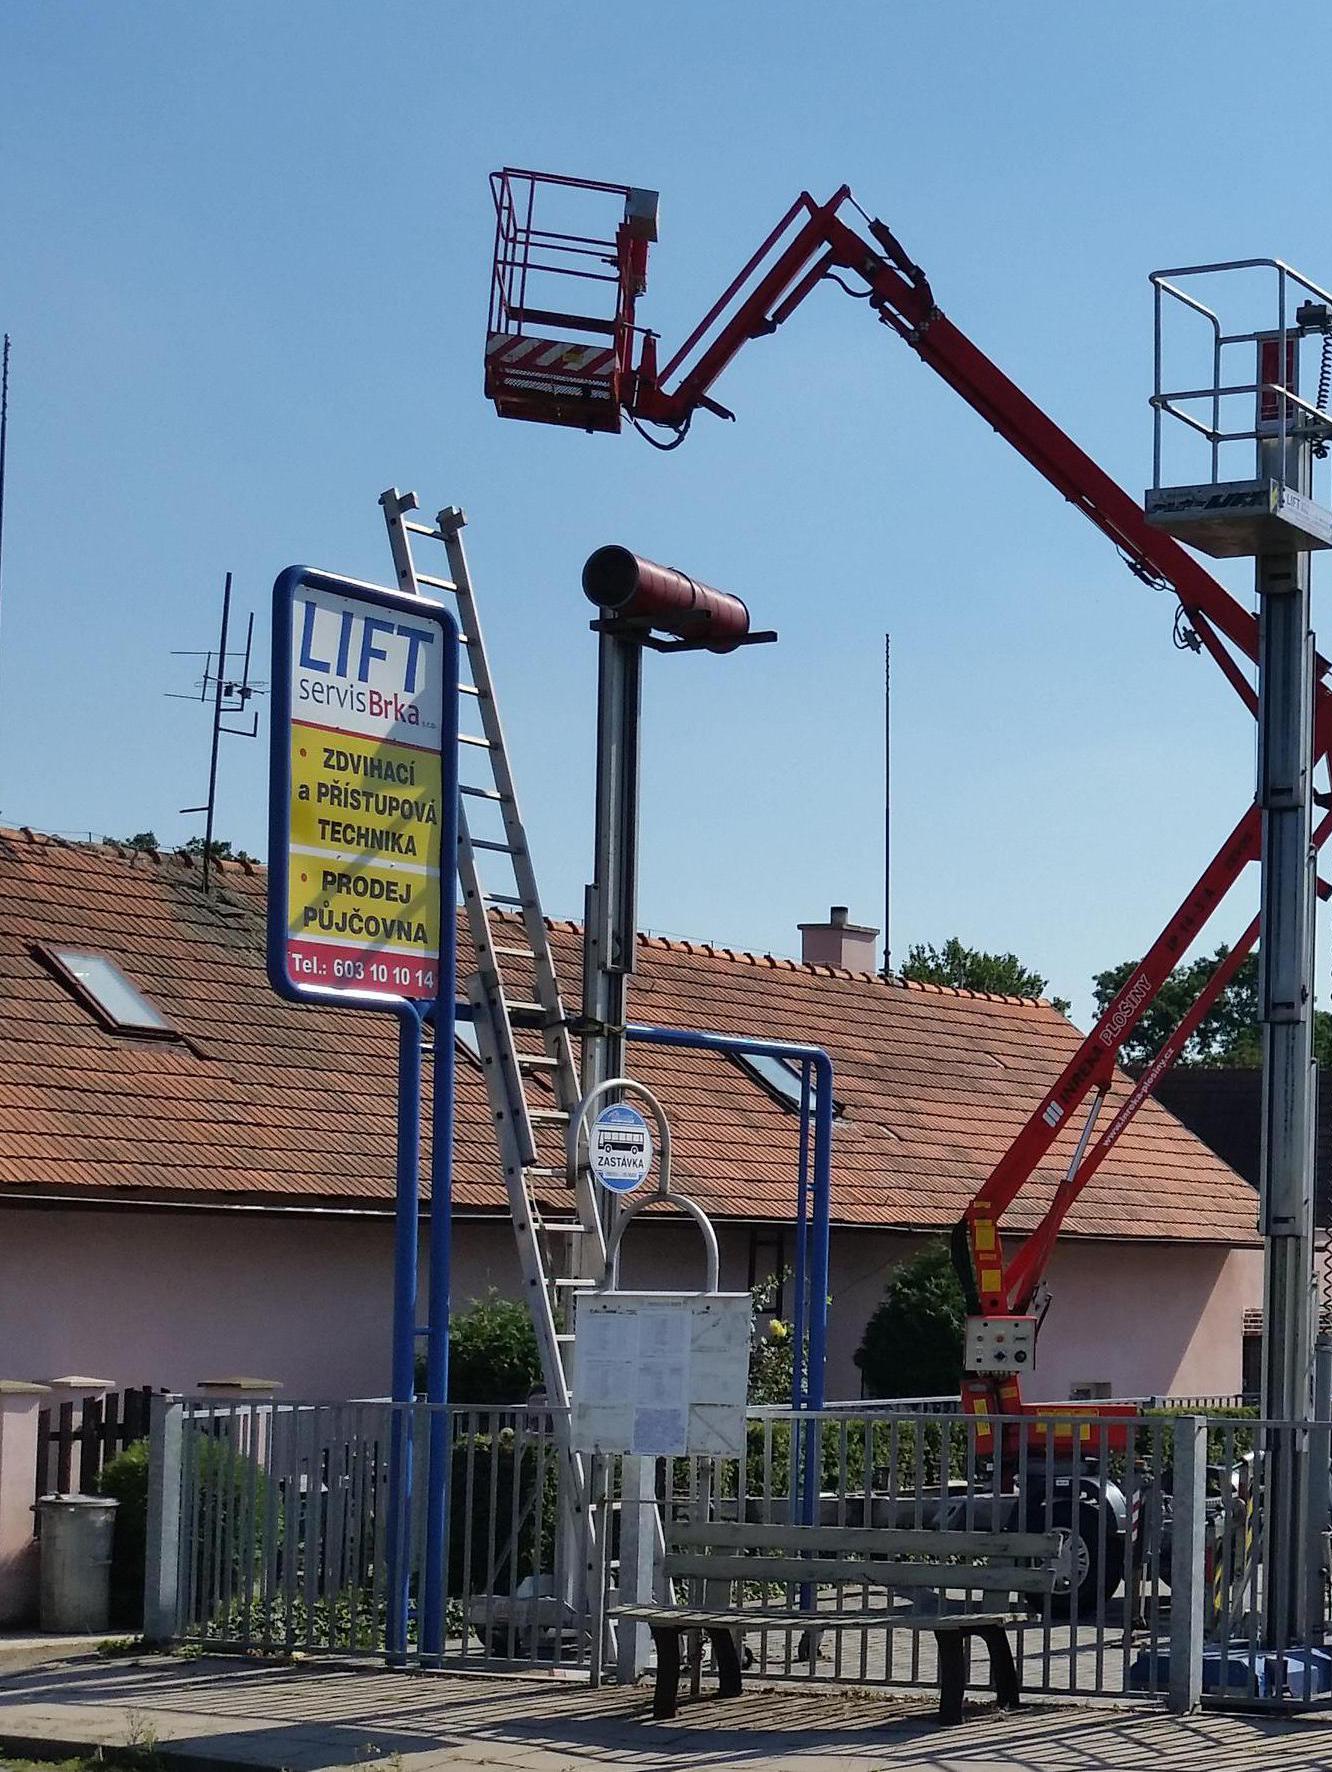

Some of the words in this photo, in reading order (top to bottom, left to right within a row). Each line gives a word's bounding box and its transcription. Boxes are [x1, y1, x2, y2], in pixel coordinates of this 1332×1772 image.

[300, 601, 435, 694] LIFT
[300, 678, 419, 725] servisBrka
[323, 747, 416, 786] ZDVIHACÍ
[298, 785, 310, 801] a
[317, 780, 437, 825] PŘÍSTUPOVÁ
[318, 819, 417, 856] TECHNIKA
[322, 870, 412, 904] PRODEJ
[303, 900, 428, 944] PŮJČOVNA
[291, 953, 327, 975] Tel.:
[333, 958, 365, 980] 603
[370, 963, 387, 983] 10
[393, 966, 410, 985] 10
[416, 970, 433, 989] 14
[1100, 973, 1150, 1047] PLOŠINY
[598, 1155, 644, 1168] ZASTÁVKA
